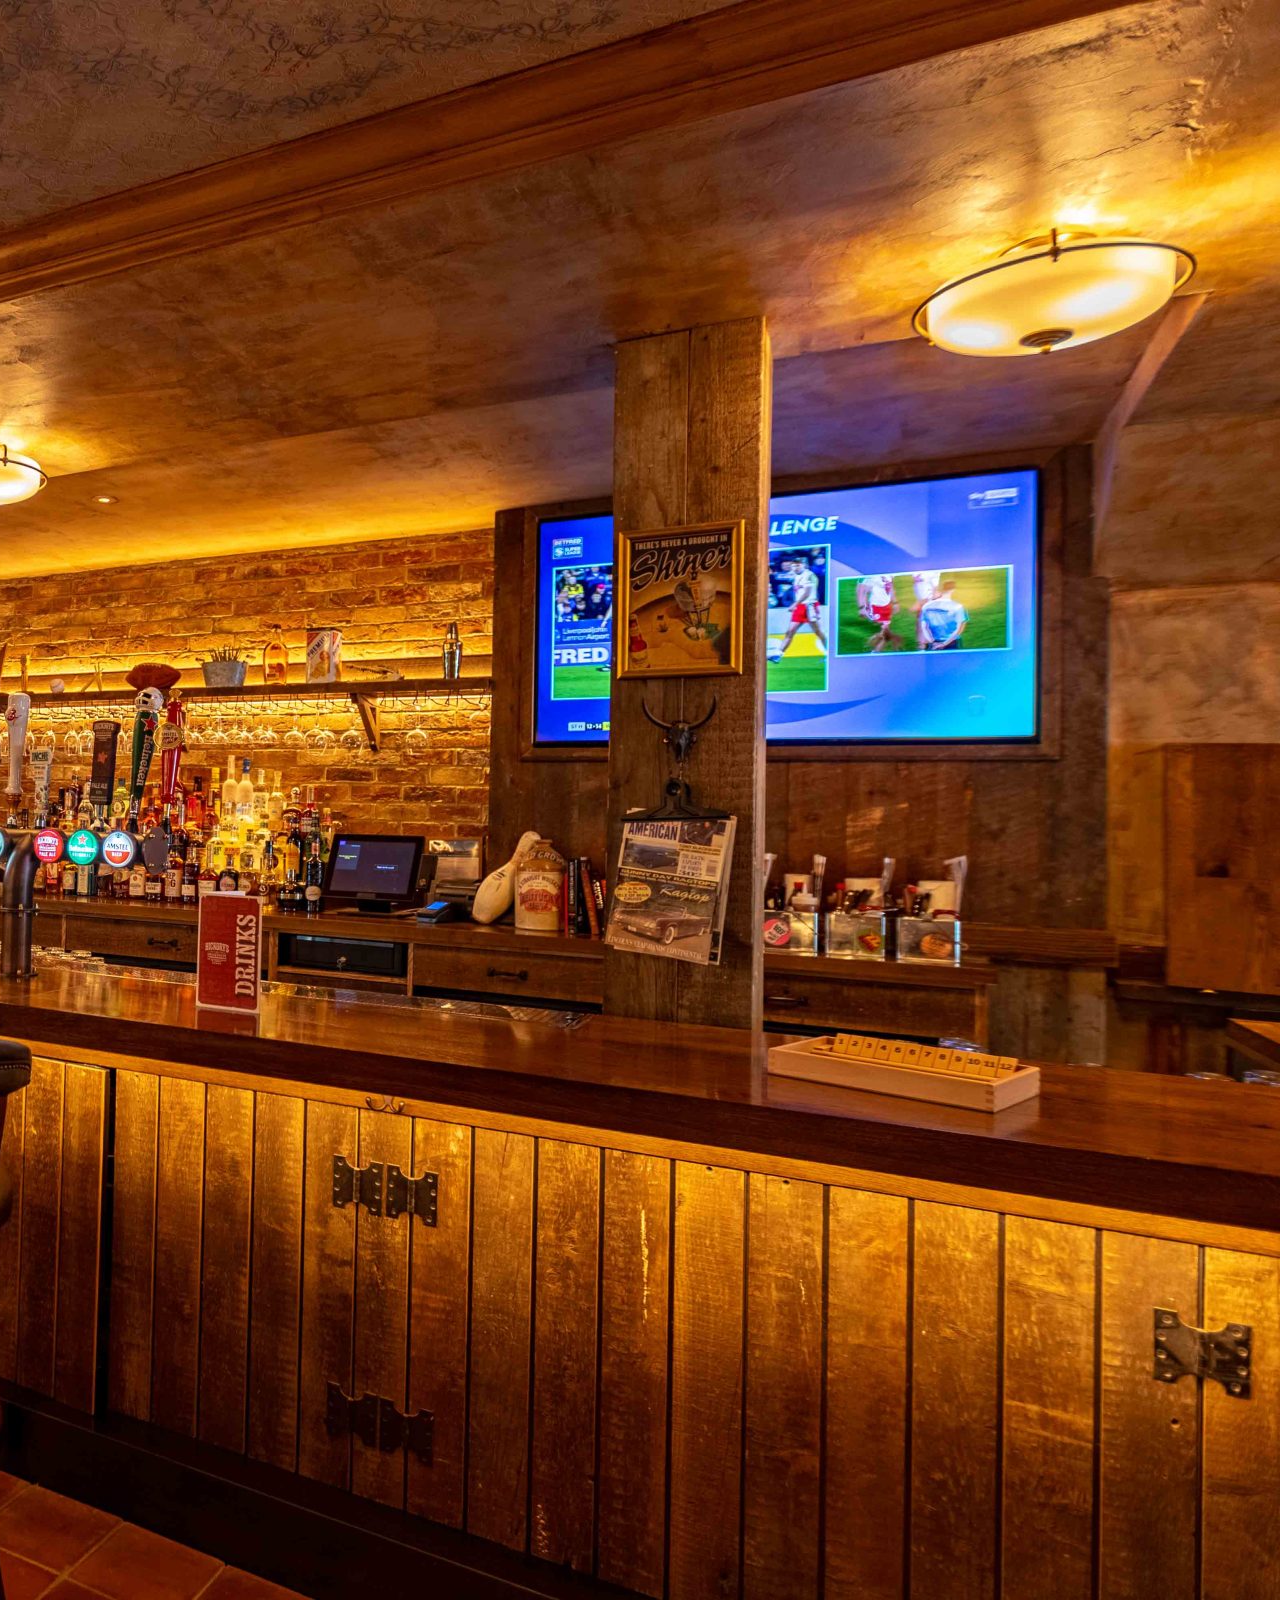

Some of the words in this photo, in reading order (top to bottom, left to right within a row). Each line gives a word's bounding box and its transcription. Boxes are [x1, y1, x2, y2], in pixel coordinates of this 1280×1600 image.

[769, 515, 840, 536] LENGE
[660, 538, 681, 548] NEVER
[683, 537, 687, 546] A
[688, 535, 718, 545] DROUGHT
[720, 533, 728, 542] IN
[630, 544, 732, 592] Shiner
[628, 821, 678, 841] AMERICAN
[659, 884, 711, 903] Ragtop
[234, 914, 256, 997] DRINKS
[967, 1057, 981, 1065] 10
[982, 1060, 995, 1068] 11
